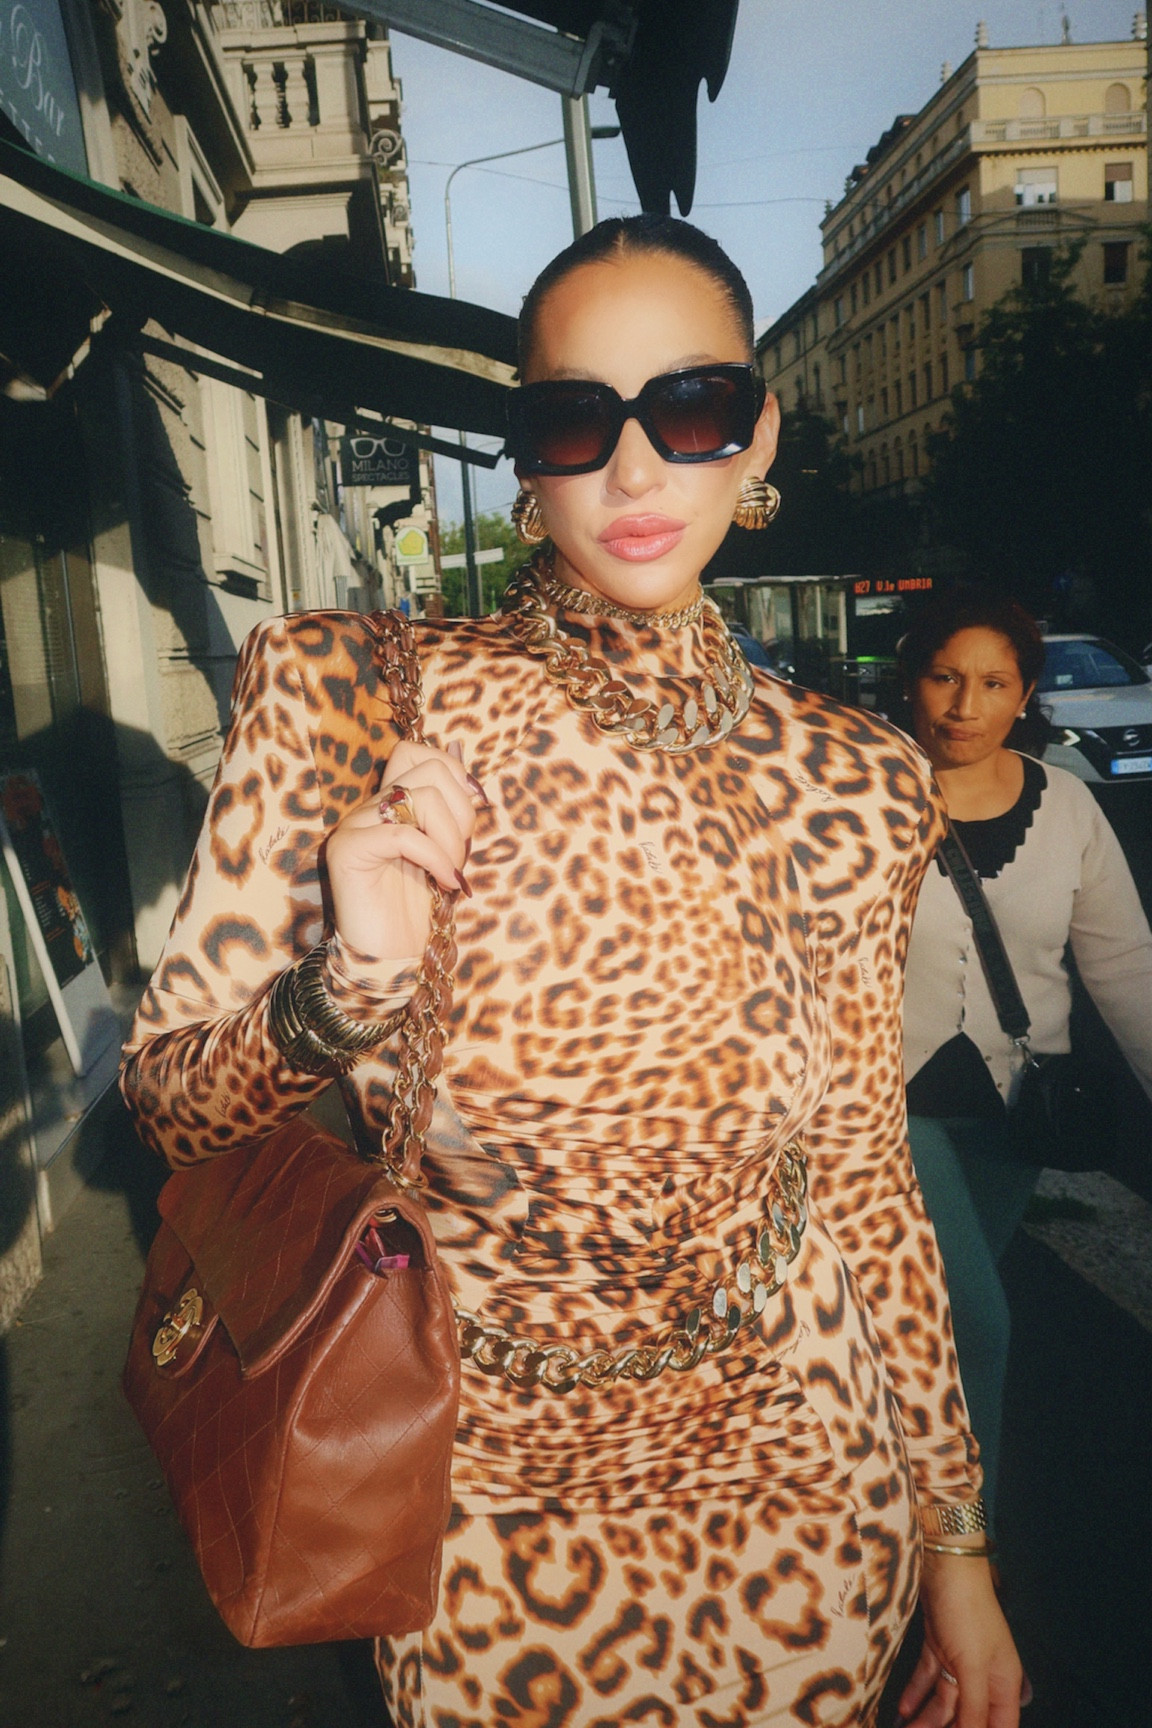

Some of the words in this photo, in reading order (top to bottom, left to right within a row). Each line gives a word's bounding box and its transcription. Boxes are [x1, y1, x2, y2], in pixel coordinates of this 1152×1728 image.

[352, 458, 409, 472] MILANO
[351, 471, 410, 483] SPECTACLES
[897, 578, 933, 591] UMBRIA
